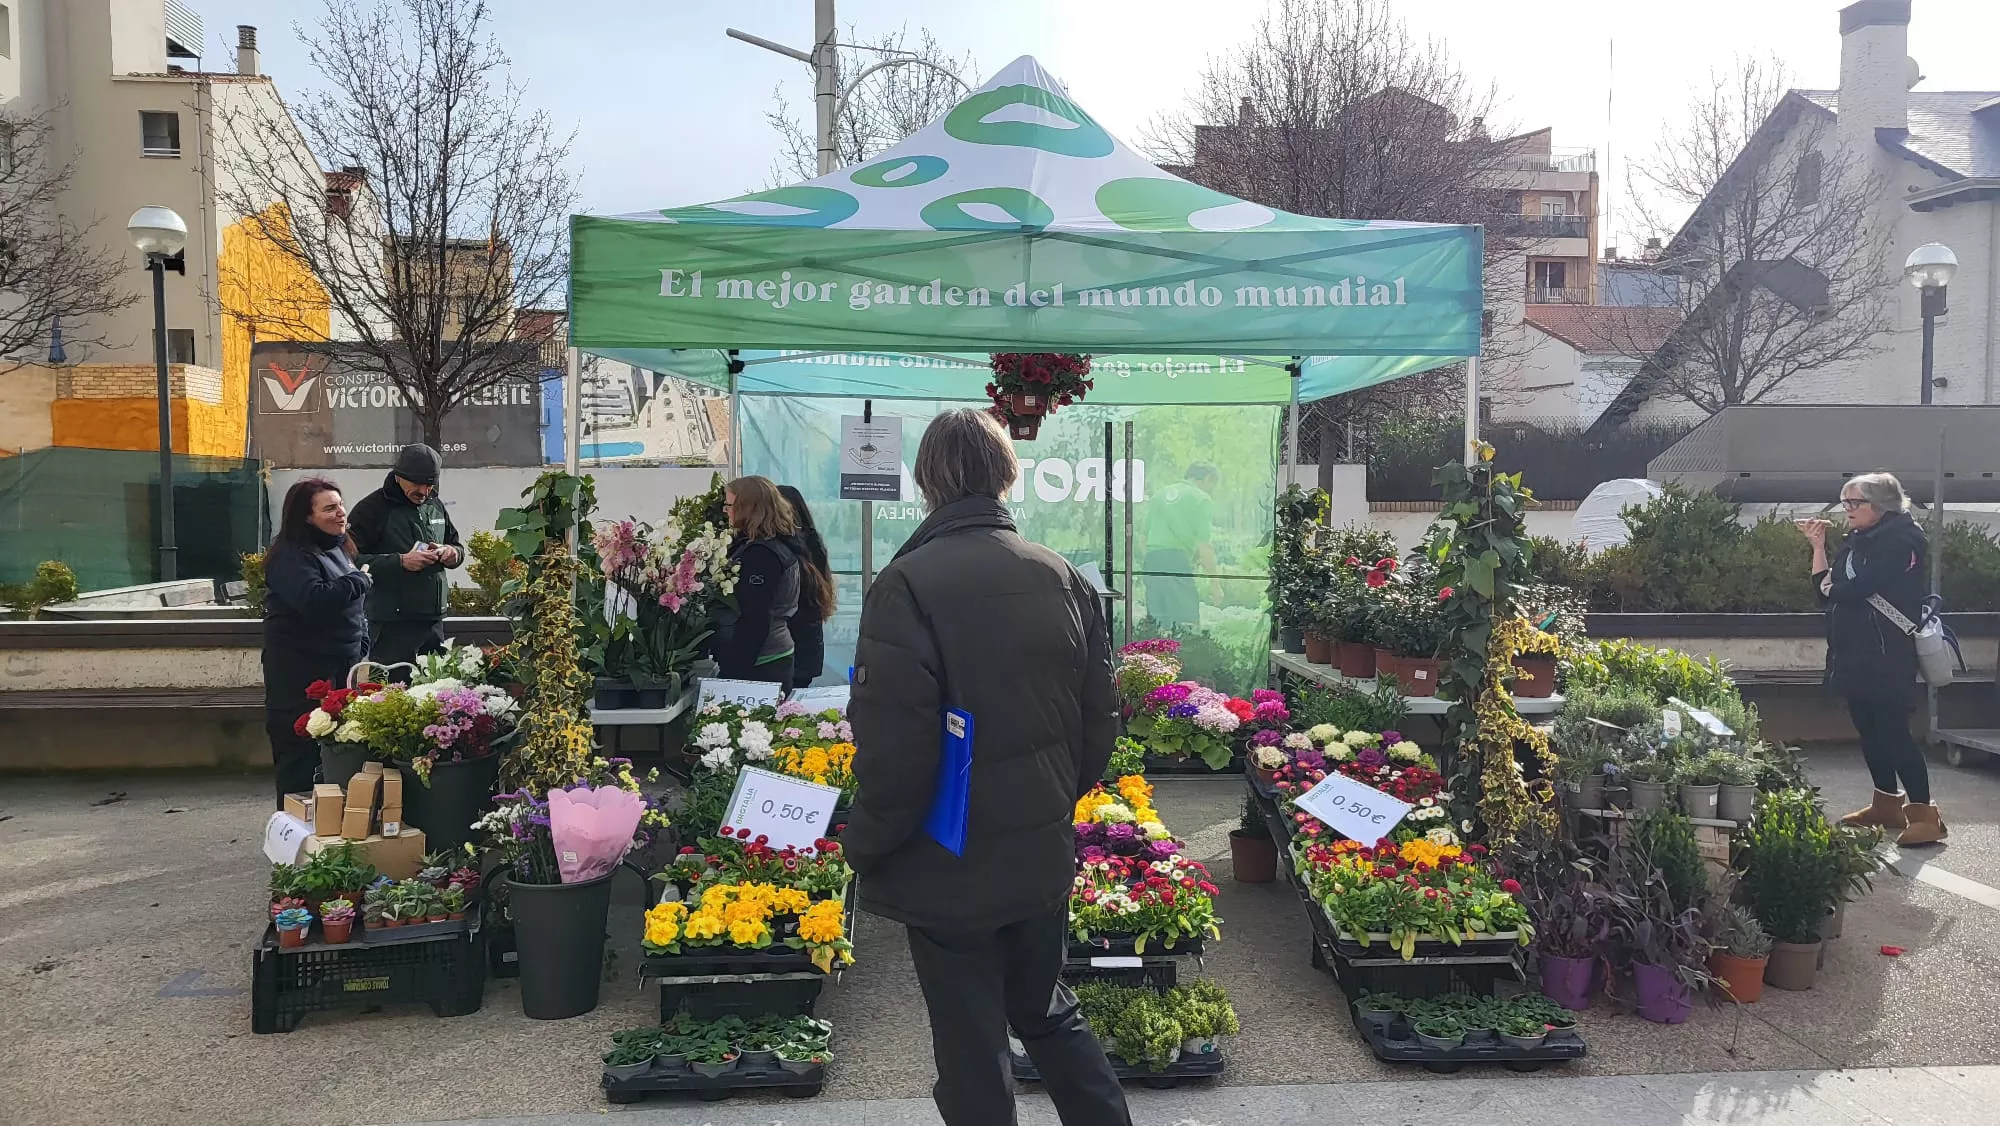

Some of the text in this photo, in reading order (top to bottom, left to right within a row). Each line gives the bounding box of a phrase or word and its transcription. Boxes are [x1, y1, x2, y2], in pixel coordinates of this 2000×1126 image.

[657, 268, 1407, 311] El mejor garden del mundo mundial
[325, 384, 425, 409] VICTORIN
[761, 799, 820, 824] 0,50€
[1332, 795, 1386, 825] 0,50€
